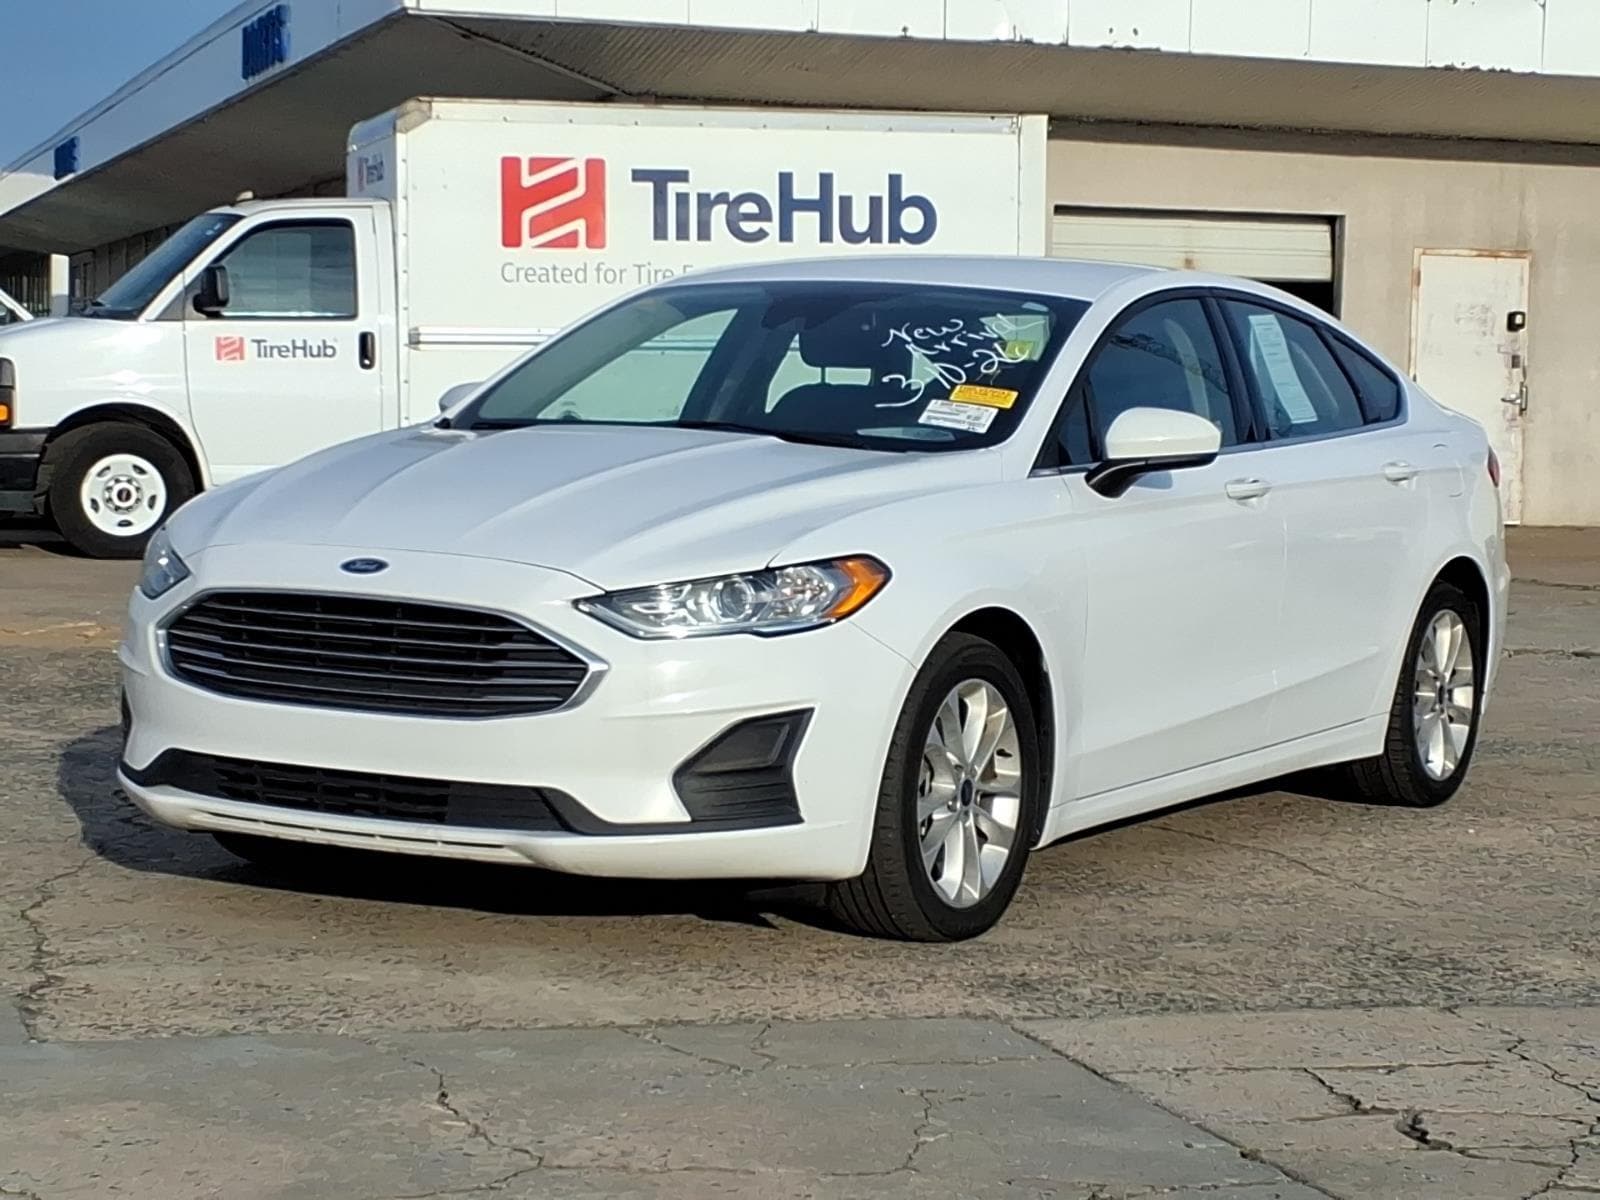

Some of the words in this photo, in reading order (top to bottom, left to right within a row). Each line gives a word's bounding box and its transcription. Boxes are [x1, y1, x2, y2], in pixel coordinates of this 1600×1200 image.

[631, 168, 937, 245] TireHub
[500, 262, 588, 284] Created
[596, 261, 627, 284] for
[633, 262, 674, 284] Tire
[881, 318, 964, 347] New
[251, 338, 337, 358] TireHub
